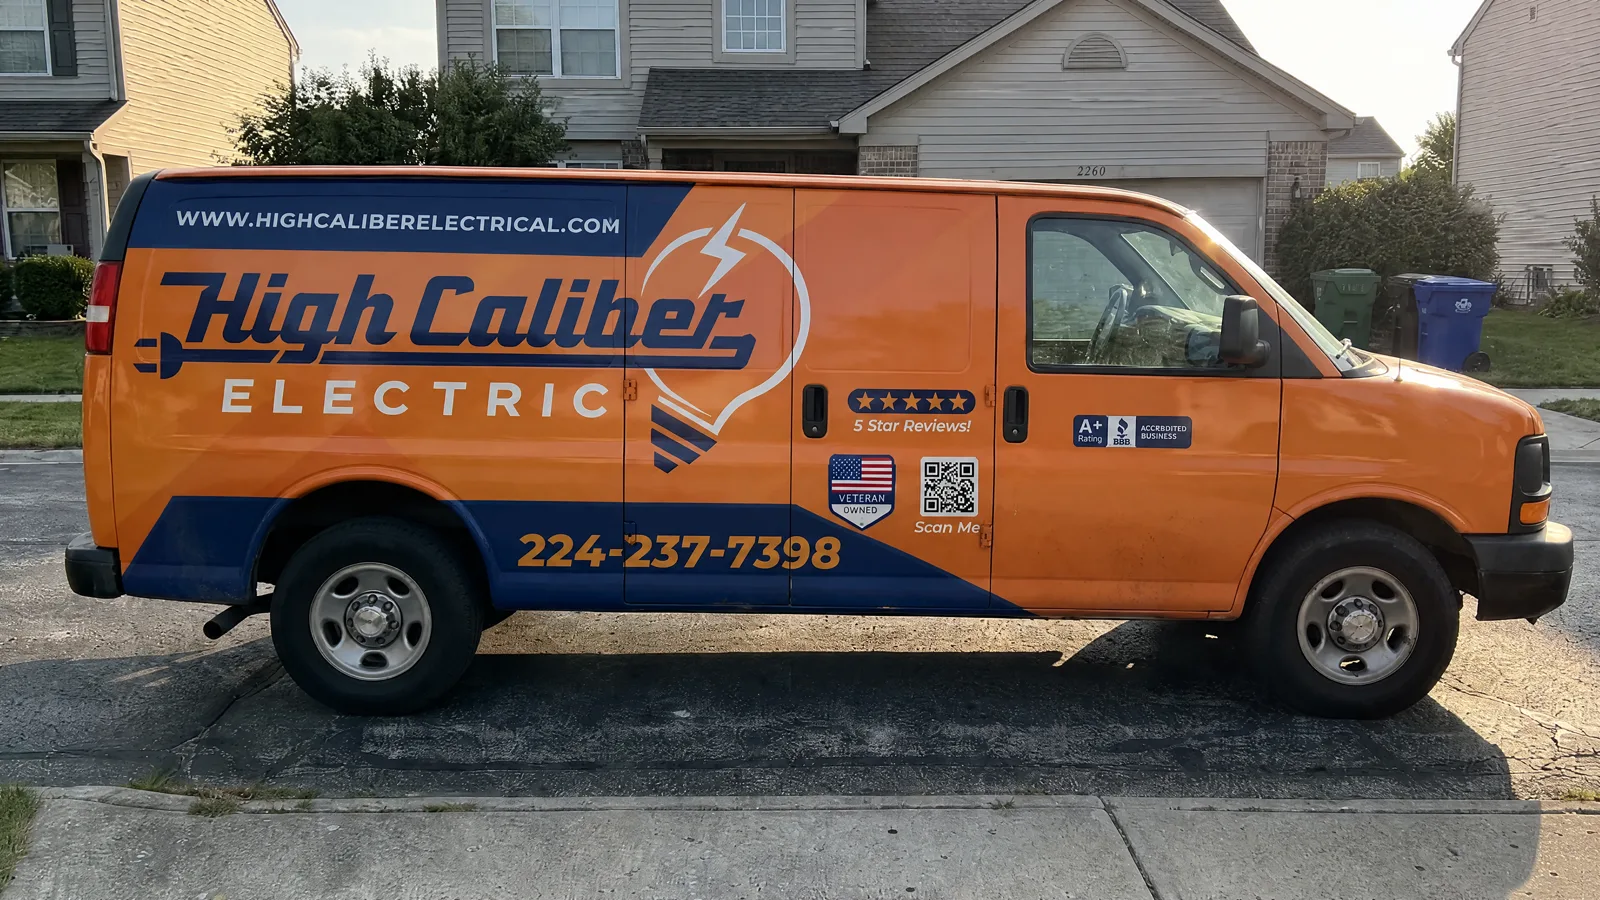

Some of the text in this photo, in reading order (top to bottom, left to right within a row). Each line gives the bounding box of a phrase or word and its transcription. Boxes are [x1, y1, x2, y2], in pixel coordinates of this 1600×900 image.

[1077, 165, 1106, 177] 2260
[176, 210, 621, 235] WWW.HIGHCALIBERELECTRICAL.COM
[160, 271, 757, 370] High Caliber
[221, 378, 608, 419] ELECTRIC
[853, 419, 972, 433] 5 Star Reviews!
[1079, 418, 1103, 434] A+
[1078, 434, 1103, 444] Rating
[1113, 438, 1131, 446] BBB
[838, 494, 885, 503] VETERAN
[843, 506, 878, 514] OWNED
[914, 521, 981, 534] Scan Me
[517, 533, 842, 570] 224-237-7398
